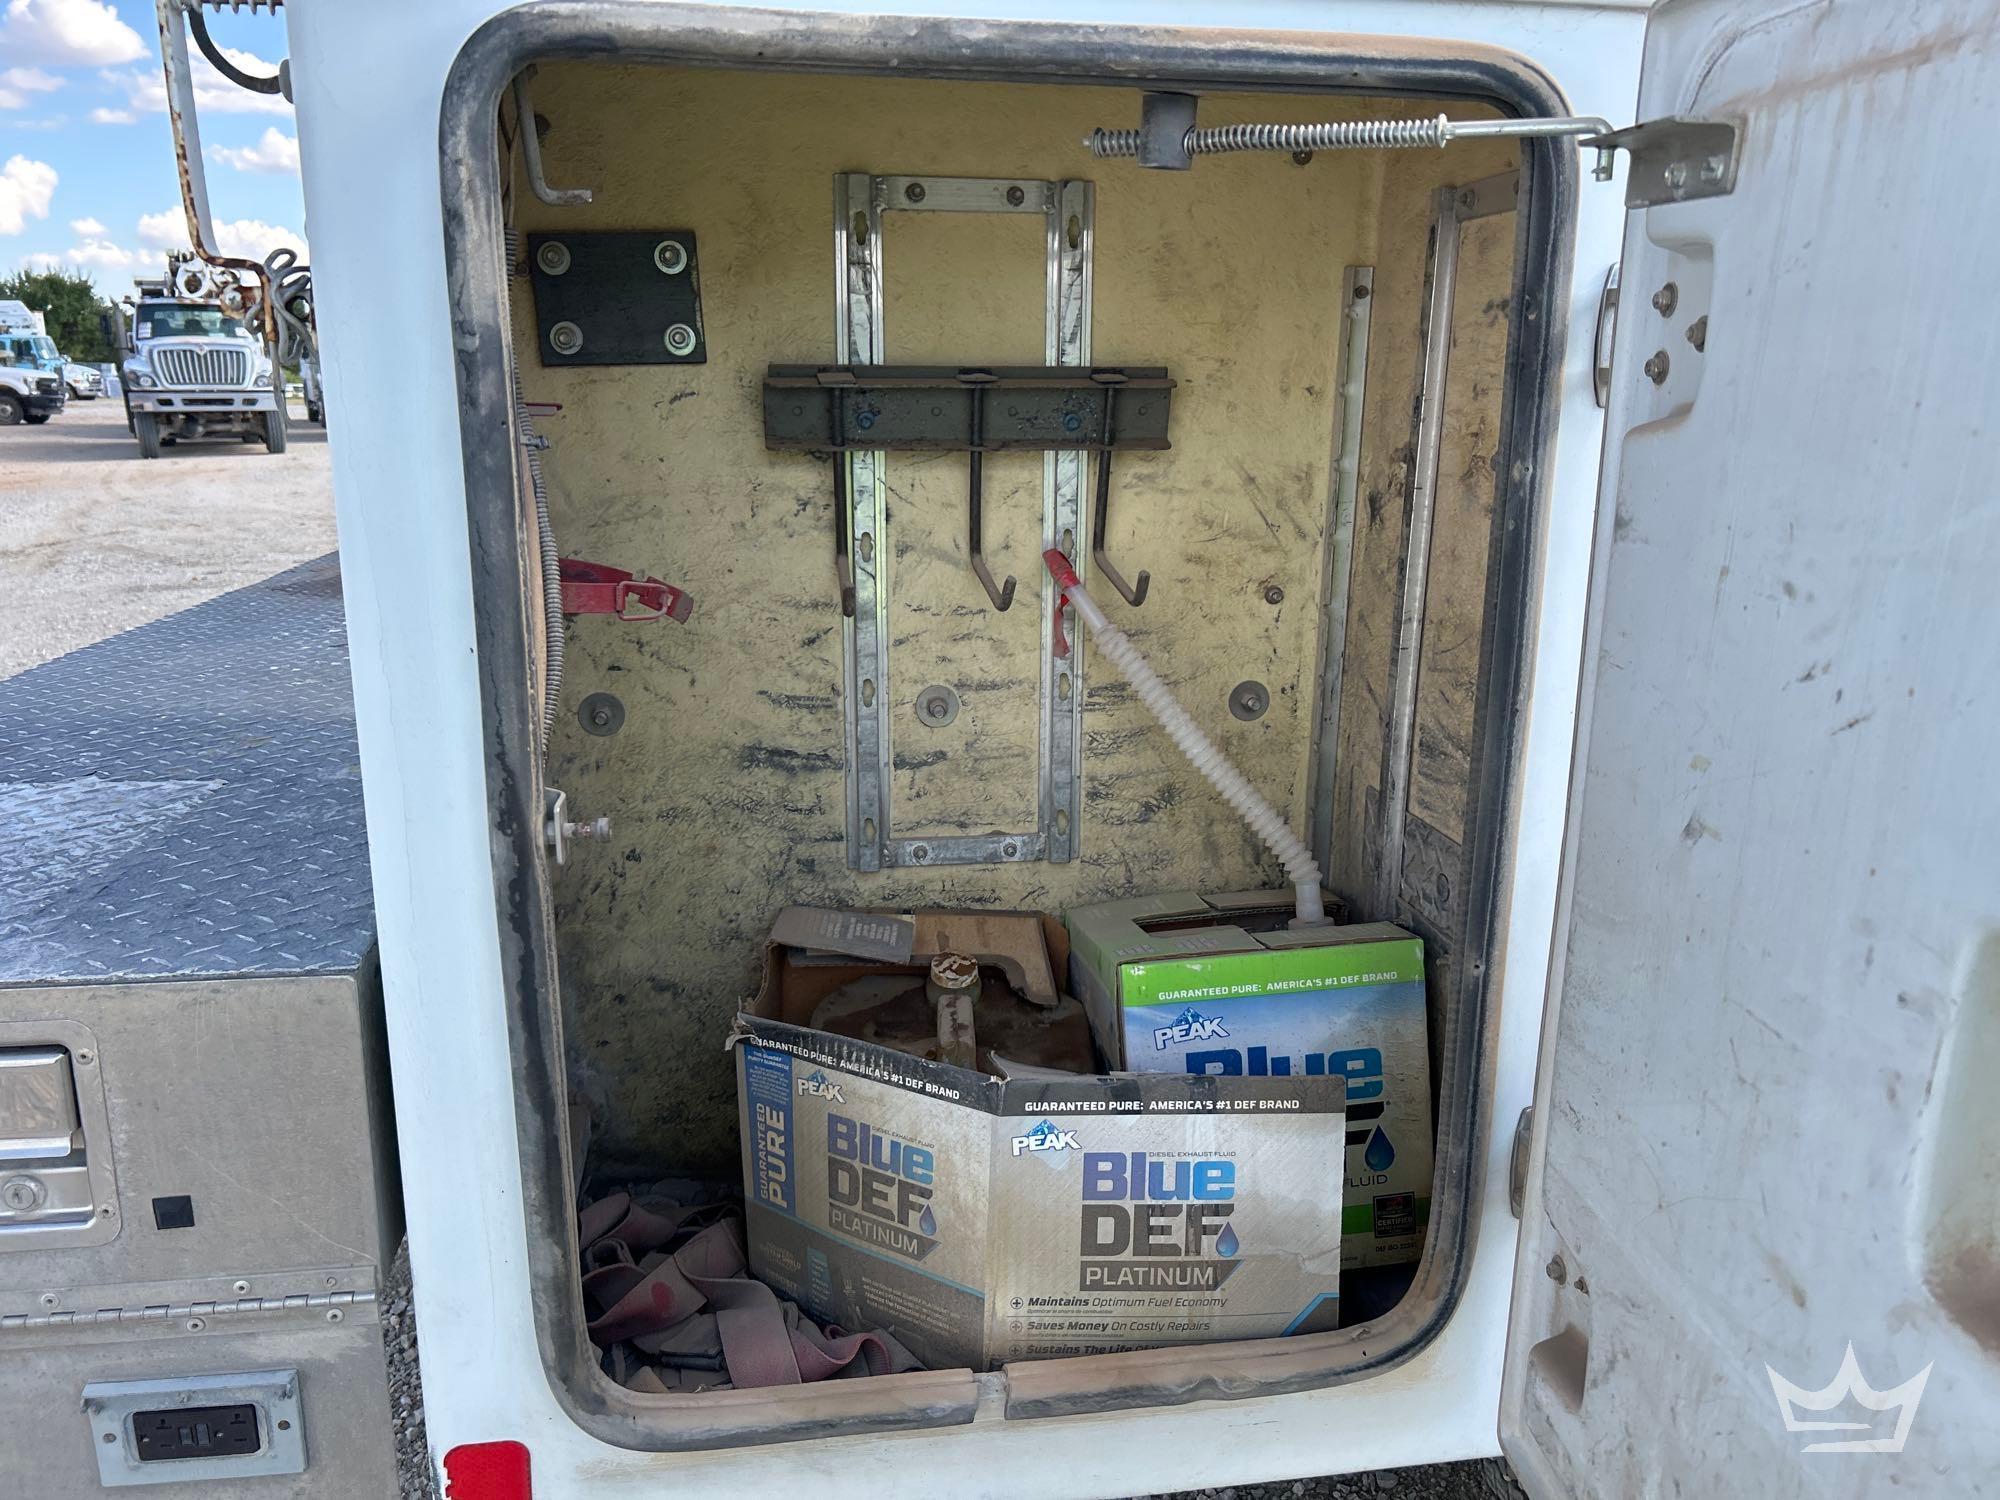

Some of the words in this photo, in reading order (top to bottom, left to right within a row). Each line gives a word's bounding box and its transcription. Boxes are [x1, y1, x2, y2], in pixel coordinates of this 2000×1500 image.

[1158, 985, 1228, 1000] GUARANTEED
[1231, 983, 1262, 994] PURE:
[1266, 978, 1322, 991] AMERICA'S
[1324, 977, 1338, 986] #1
[1340, 974, 1361, 984] DEF
[1362, 971, 1398, 983] BRAND
[1154, 1017, 1230, 1050] PEAK
[797, 1077, 847, 1104] PEAK
[891, 1073, 903, 1084] #1
[905, 1077, 924, 1090] DEF
[926, 1082, 960, 1100] BRAND
[1024, 1101, 1106, 1111] GUARANTEED
[1108, 1100, 1144, 1110] PURE:
[1149, 1100, 1214, 1110] AMERICA'S
[1216, 1100, 1232, 1109] #1
[1234, 1099, 1257, 1109] DEF
[1259, 1099, 1300, 1109] BRAND
[756, 1103, 769, 1199] GUARANTEED
[765, 1105, 788, 1208] PURE
[828, 1112, 935, 1185] Blue
[1010, 1129, 1082, 1156] PEAK
[1082, 1151, 1236, 1201] Blue
[1343, 1174, 1388, 1188] LUID
[828, 1155, 934, 1228] DEF
[831, 1209, 919, 1255] PLATINUM
[1080, 1203, 1235, 1257] DEF
[1085, 1267, 1214, 1286] PLATINUM
[1028, 1297, 1090, 1307] Maintains
[1092, 1297, 1145, 1308] Optimum
[1148, 1297, 1173, 1307] Fuel
[1175, 1297, 1229, 1308] Economy
[1027, 1321, 1067, 1331] Saves
[1067, 1321, 1109, 1333] Money
[1111, 1321, 1127, 1331] On
[1129, 1320, 1166, 1333] Costly
[1167, 1321, 1211, 1333] Repairs
[1027, 1343, 1081, 1354] Sustains
[1083, 1344, 1106, 1354] The
[1108, 1343, 1133, 1353] Life
